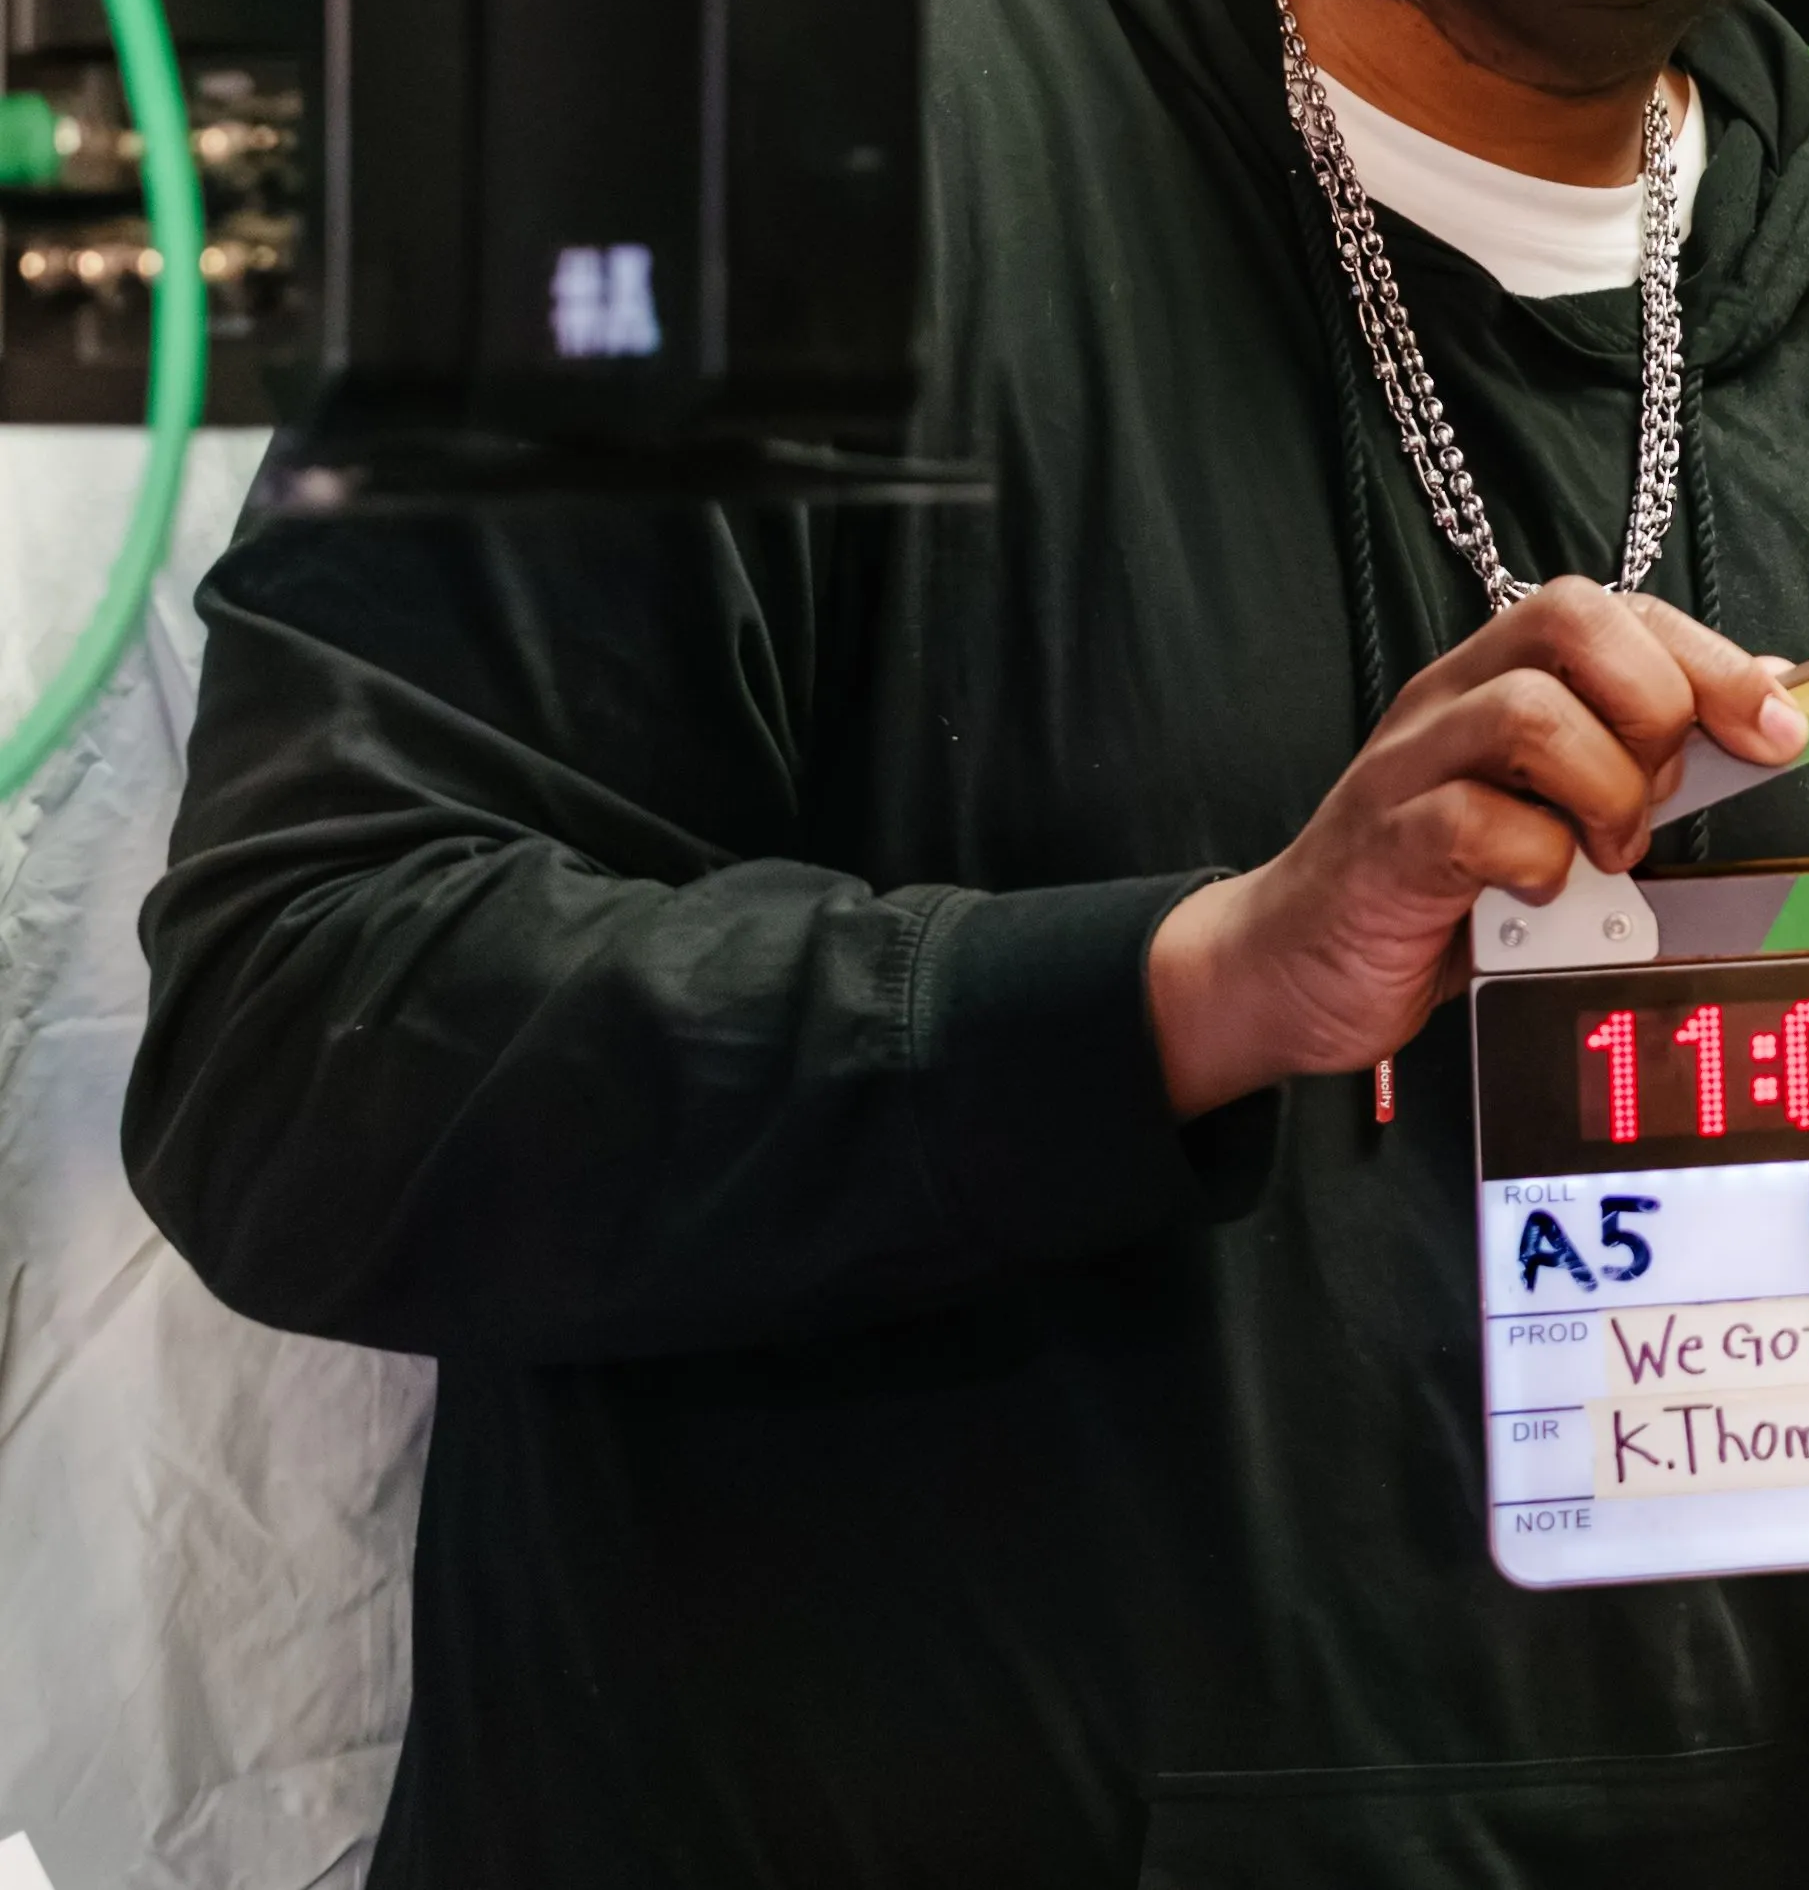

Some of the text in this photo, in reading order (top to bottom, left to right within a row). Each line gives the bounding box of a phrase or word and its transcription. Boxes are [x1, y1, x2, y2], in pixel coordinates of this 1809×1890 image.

[1503, 1182, 1577, 1205] ROLL
[1518, 1195, 1662, 1294] A5
[1508, 1321, 1589, 1346] PROD
[1610, 1312, 1706, 1386] We
[1512, 1419, 1560, 1443] DIR
[1515, 1510, 1591, 1534] NOTE
